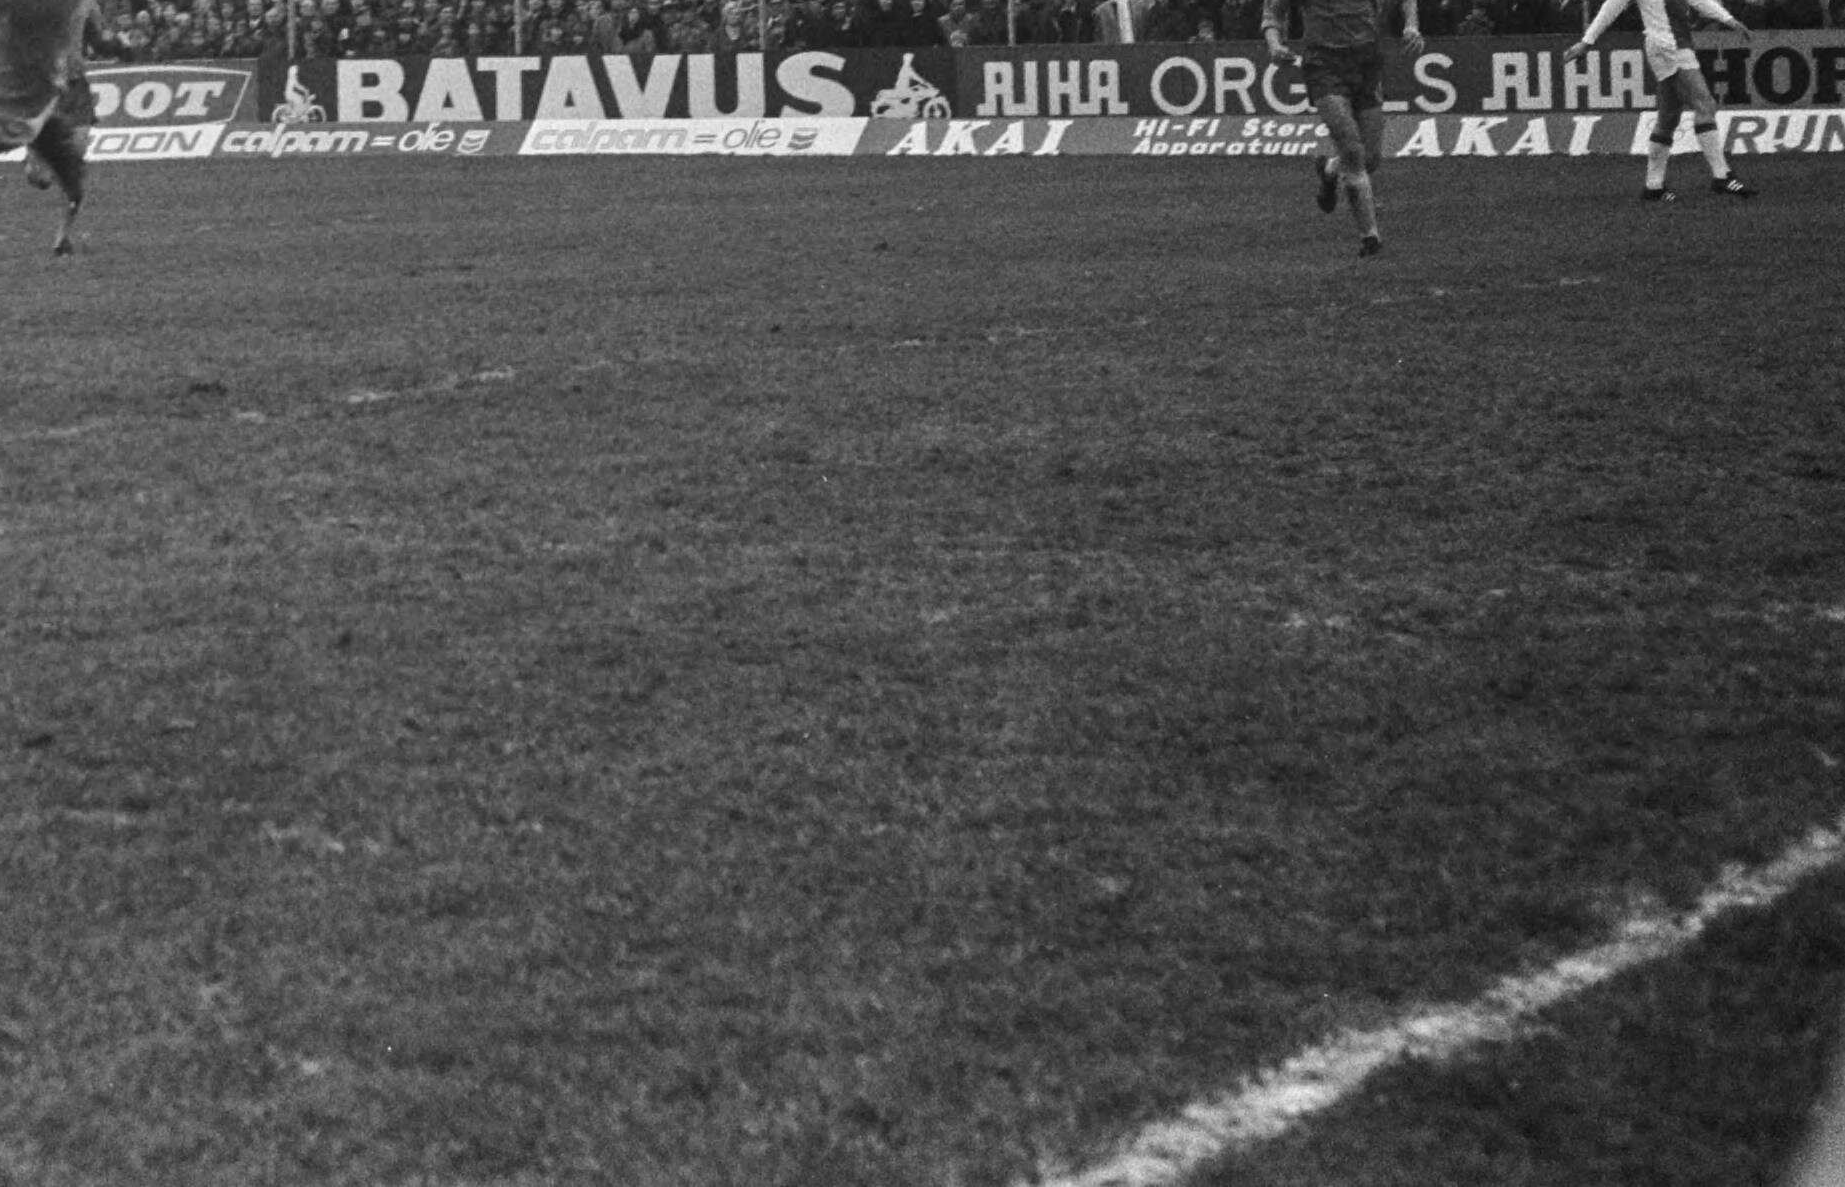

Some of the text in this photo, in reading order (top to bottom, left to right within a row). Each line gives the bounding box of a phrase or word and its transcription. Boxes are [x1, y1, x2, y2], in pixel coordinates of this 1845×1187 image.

[336, 52, 855, 121] BATAVUS
[1151, 53, 1457, 114] ORGS
[221, 124, 368, 157] calpam
[398, 123, 454, 152] olie
[532, 119, 690, 152] calpam
[724, 120, 781, 149] olie
[887, 119, 1073, 155] AKAI
[1133, 118, 1220, 137] HI-FI
[1396, 116, 1601, 157] AKAI
[1133, 137, 1317, 155] Apparatuur
